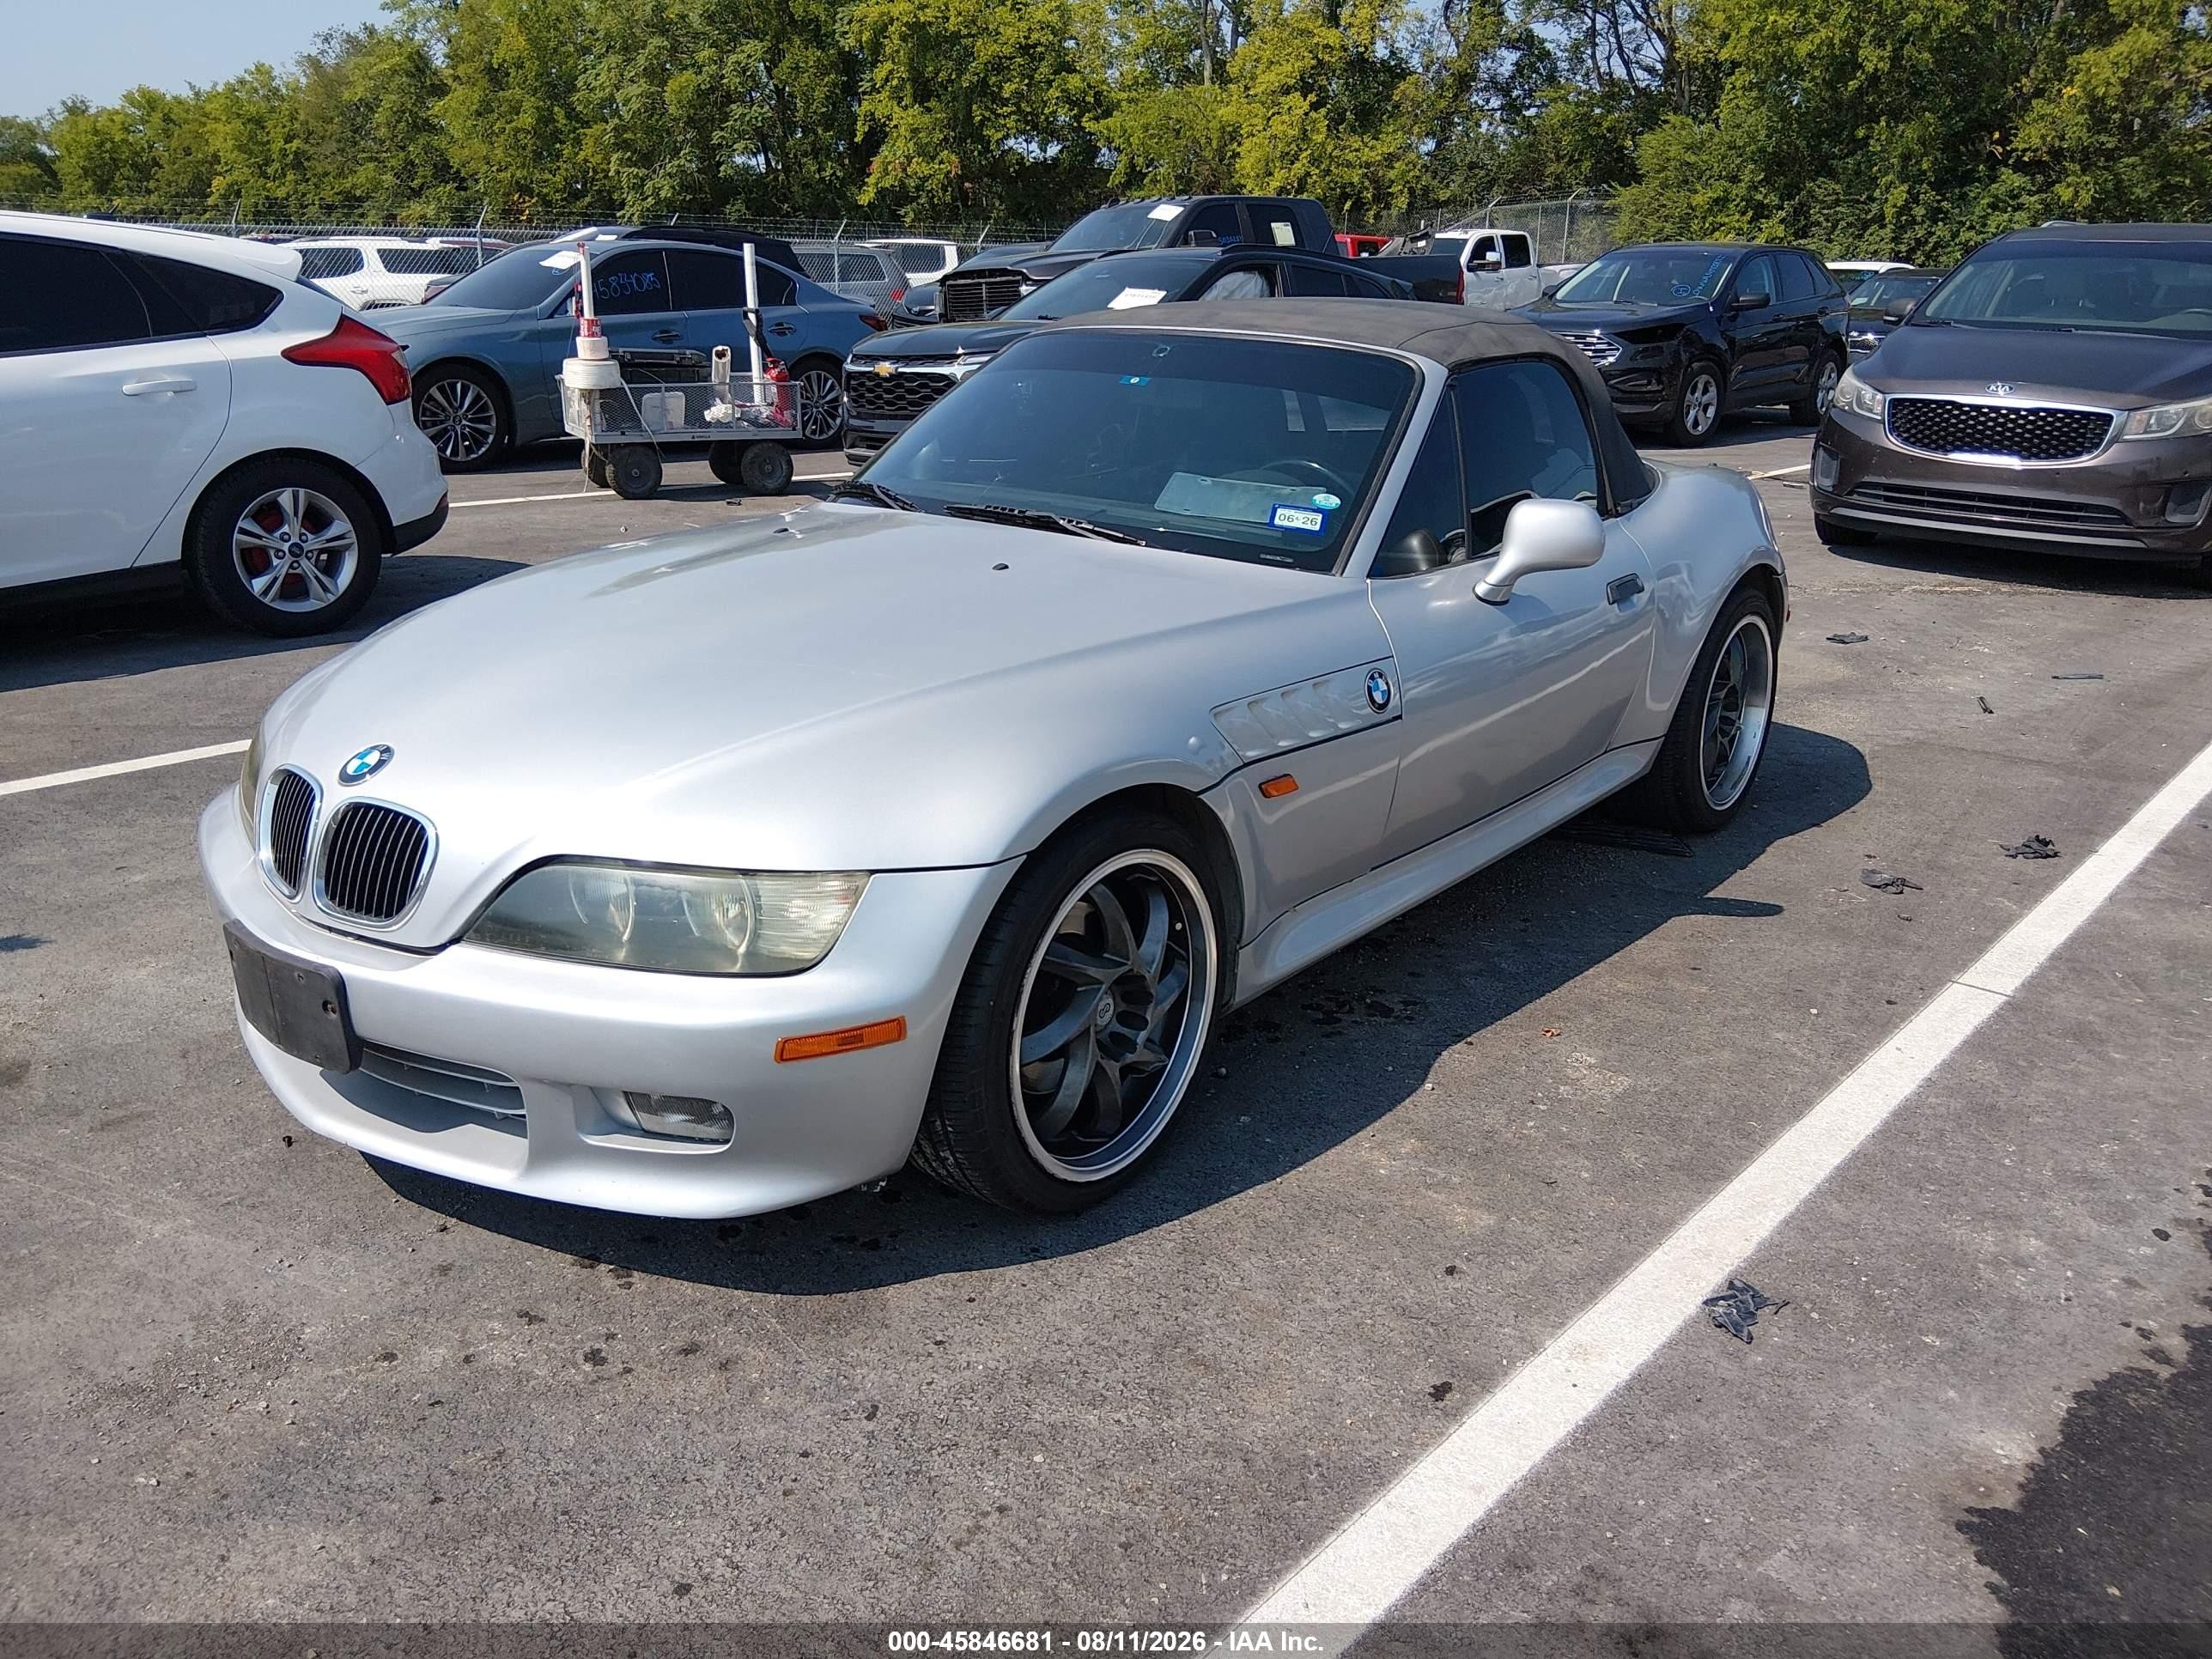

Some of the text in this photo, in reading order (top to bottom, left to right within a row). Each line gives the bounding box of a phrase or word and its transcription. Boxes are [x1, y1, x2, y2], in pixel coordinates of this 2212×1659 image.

[1988, 384, 2010, 392] KIA
[1278, 513, 1319, 526] 06 26
